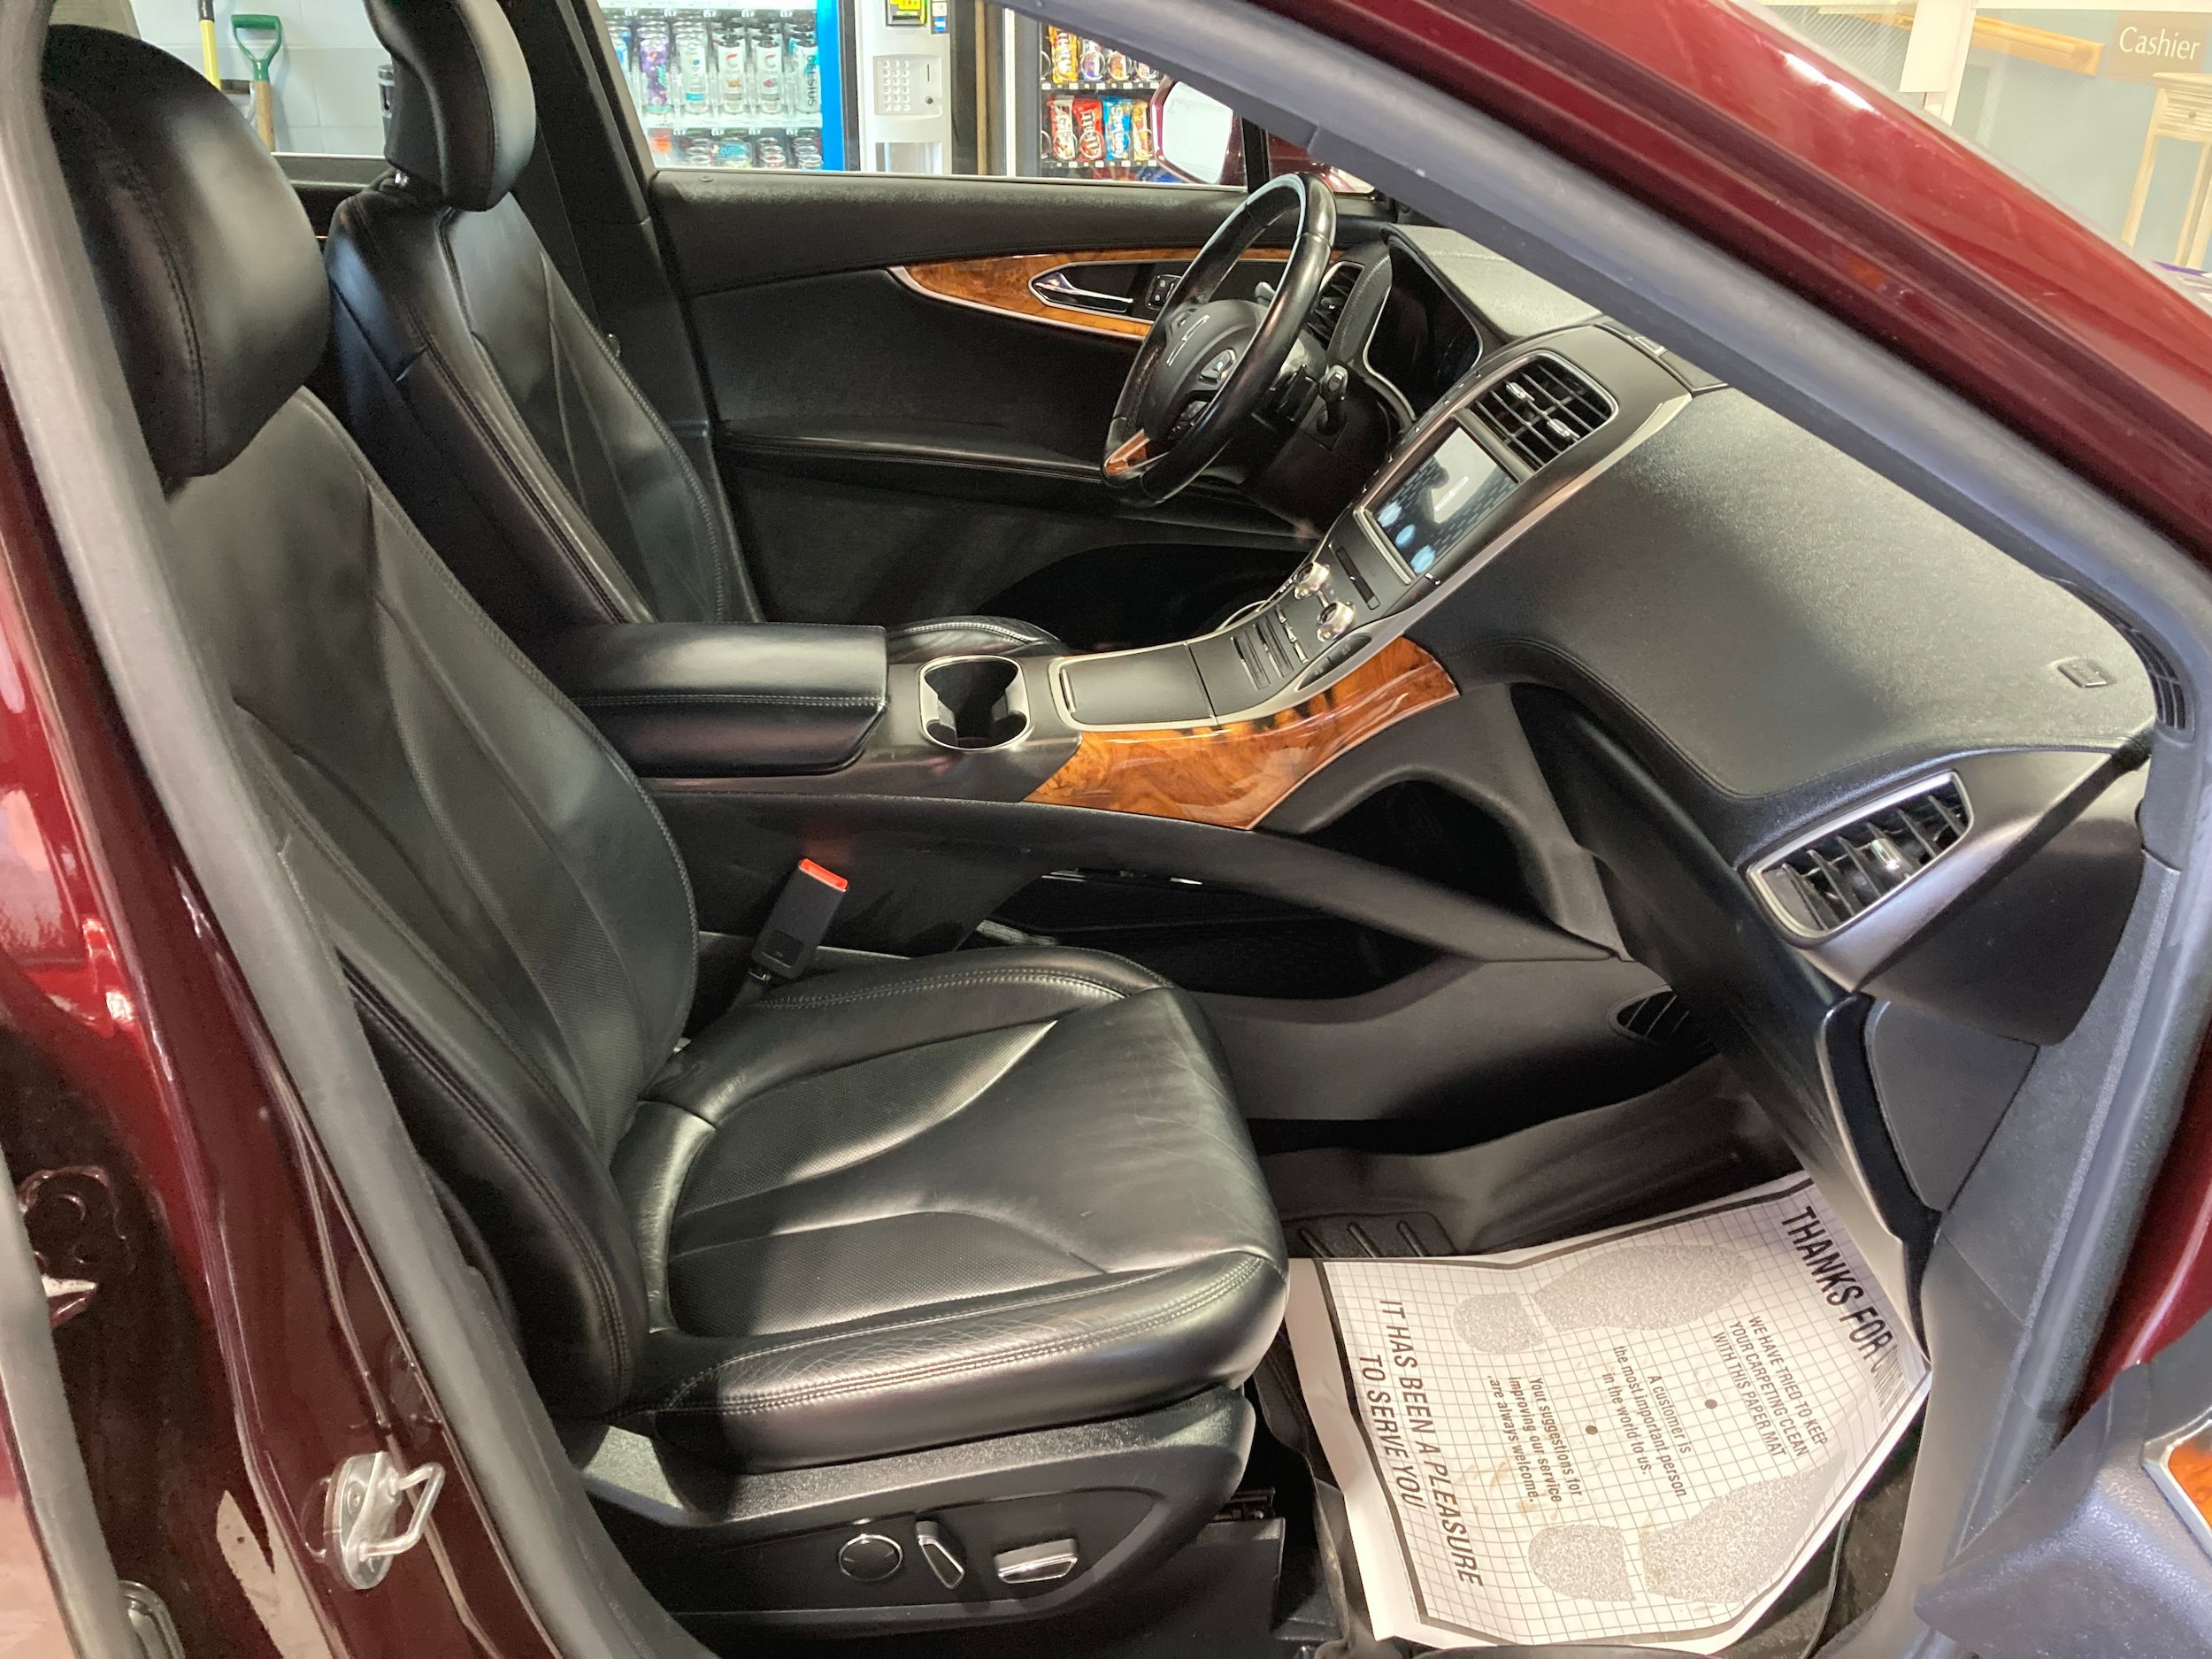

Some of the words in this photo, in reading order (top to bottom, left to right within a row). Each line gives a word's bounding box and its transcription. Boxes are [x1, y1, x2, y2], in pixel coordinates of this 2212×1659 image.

[2119, 27, 2200, 60] Cashier
[1781, 1205, 1864, 1306] THANKS
[1839, 1306, 1893, 1360] FOR
[1379, 1300, 1406, 1319] IT
[1359, 1355, 1386, 1381] TO
[1386, 1325, 1417, 1368] HAS
[1601, 1372, 1616, 1384] in
[1608, 1386, 1623, 1403] the
[1647, 1375, 1662, 1384] A
[1713, 1332, 1738, 1363] WITH
[1728, 1363, 1751, 1389] THIS
[1741, 1391, 1771, 1430] PAPER
[1762, 1431, 1786, 1456] MAT
[1730, 1321, 1754, 1352] YOUR
[1746, 1353, 1788, 1417] CARPETING
[1779, 1418, 1809, 1457] CLEAN
[1748, 1316, 1768, 1335] WE
[1758, 1335, 1784, 1366] HAVE
[1775, 1366, 1802, 1401] TRIED
[1794, 1401, 1812, 1417] TO
[1803, 1419, 1828, 1445] KEEP
[1367, 1390, 1409, 1459] SERVE
[1399, 1377, 1437, 1433] BEEN
[1613, 1346, 1628, 1363] the
[1622, 1366, 1640, 1394] most
[1634, 1394, 1670, 1452] important
[1655, 1455, 1687, 1497] person
[1617, 1407, 1641, 1439] world
[1653, 1386, 1686, 1440] customer
[1416, 1441, 1441, 1454] A
[1497, 1402, 1519, 1442] always
[1511, 1444, 1539, 1502] welcome.
[1509, 1377, 1536, 1432] improving
[1529, 1435, 1545, 1455] our
[1537, 1458, 1563, 1502] service
[1529, 1377, 1547, 1402] Your
[1540, 1405, 1574, 1475] suggestions
[1566, 1479, 1583, 1496] for
[1631, 1440, 1644, 1454] to
[1678, 1441, 1692, 1454] is
[1392, 1465, 1427, 1509] YOU
[1636, 1456, 1652, 1474] us.
[1424, 1461, 1484, 1587] PLEASURE
